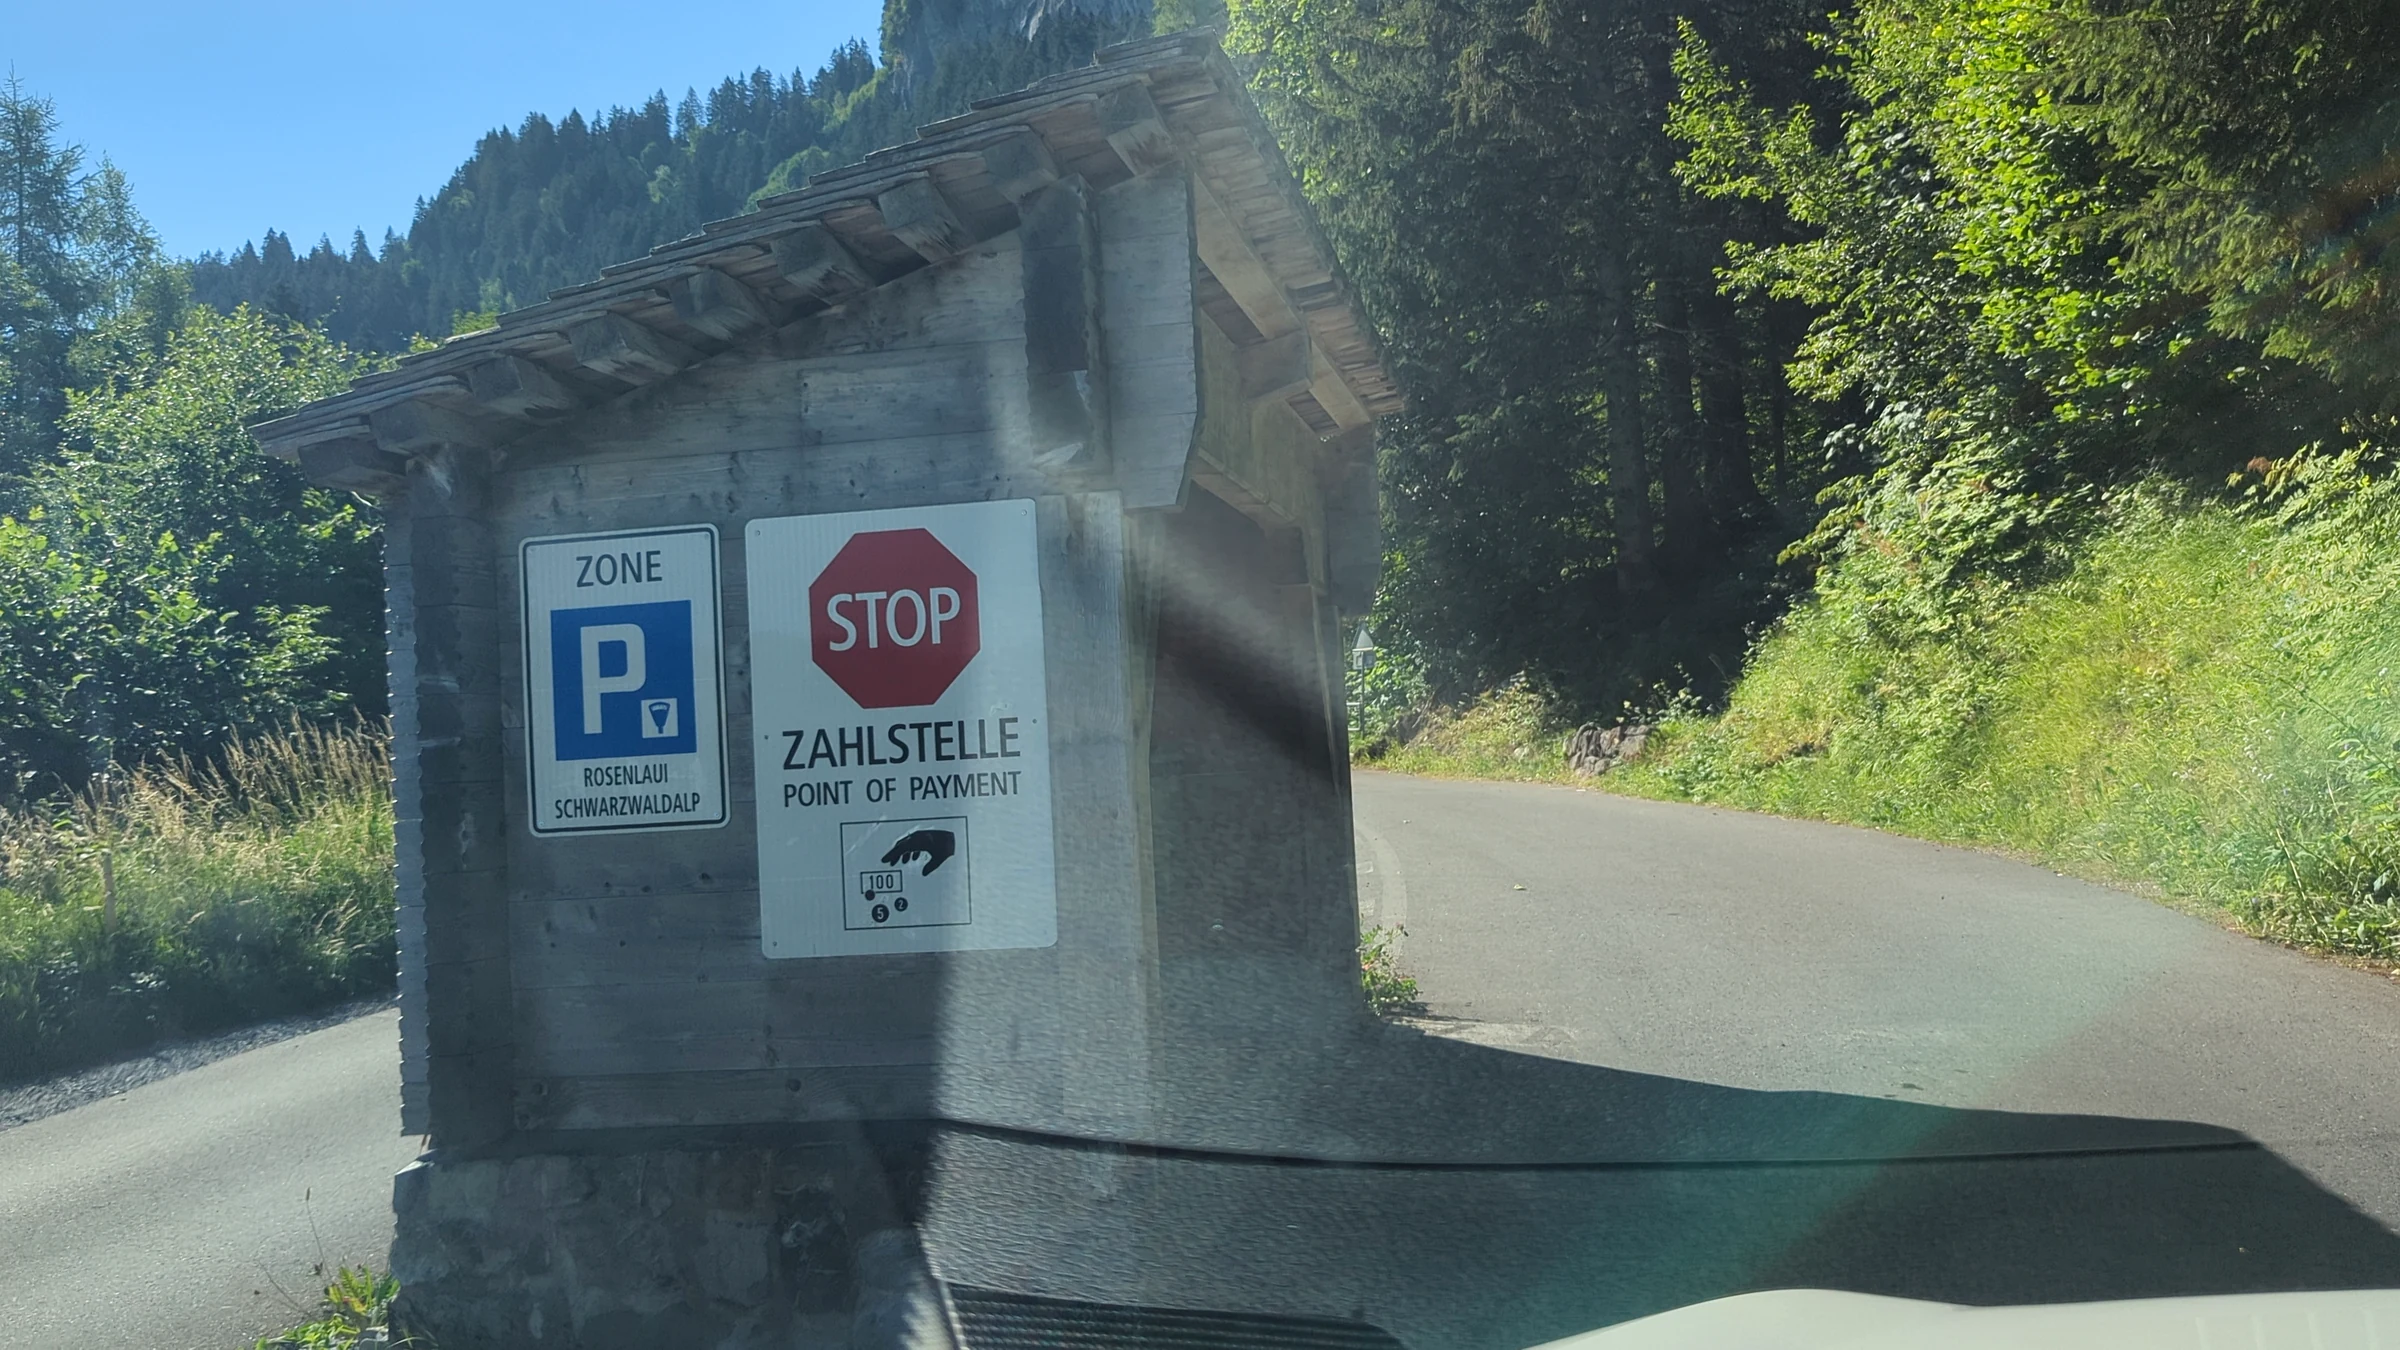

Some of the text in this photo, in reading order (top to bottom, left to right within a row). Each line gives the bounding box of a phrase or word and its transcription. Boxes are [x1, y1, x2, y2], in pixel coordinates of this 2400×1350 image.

[575, 550, 663, 588] ZONE
[826, 587, 962, 652] STOP
[579, 622, 648, 735] P
[782, 716, 1021, 770] ZAHLSTELLE
[583, 763, 668, 788] ROSENLAUI
[783, 770, 1022, 808] POINT OF PAYMENT
[555, 792, 701, 819] SCHWARZWALDALP
[869, 874, 894, 890] 100
